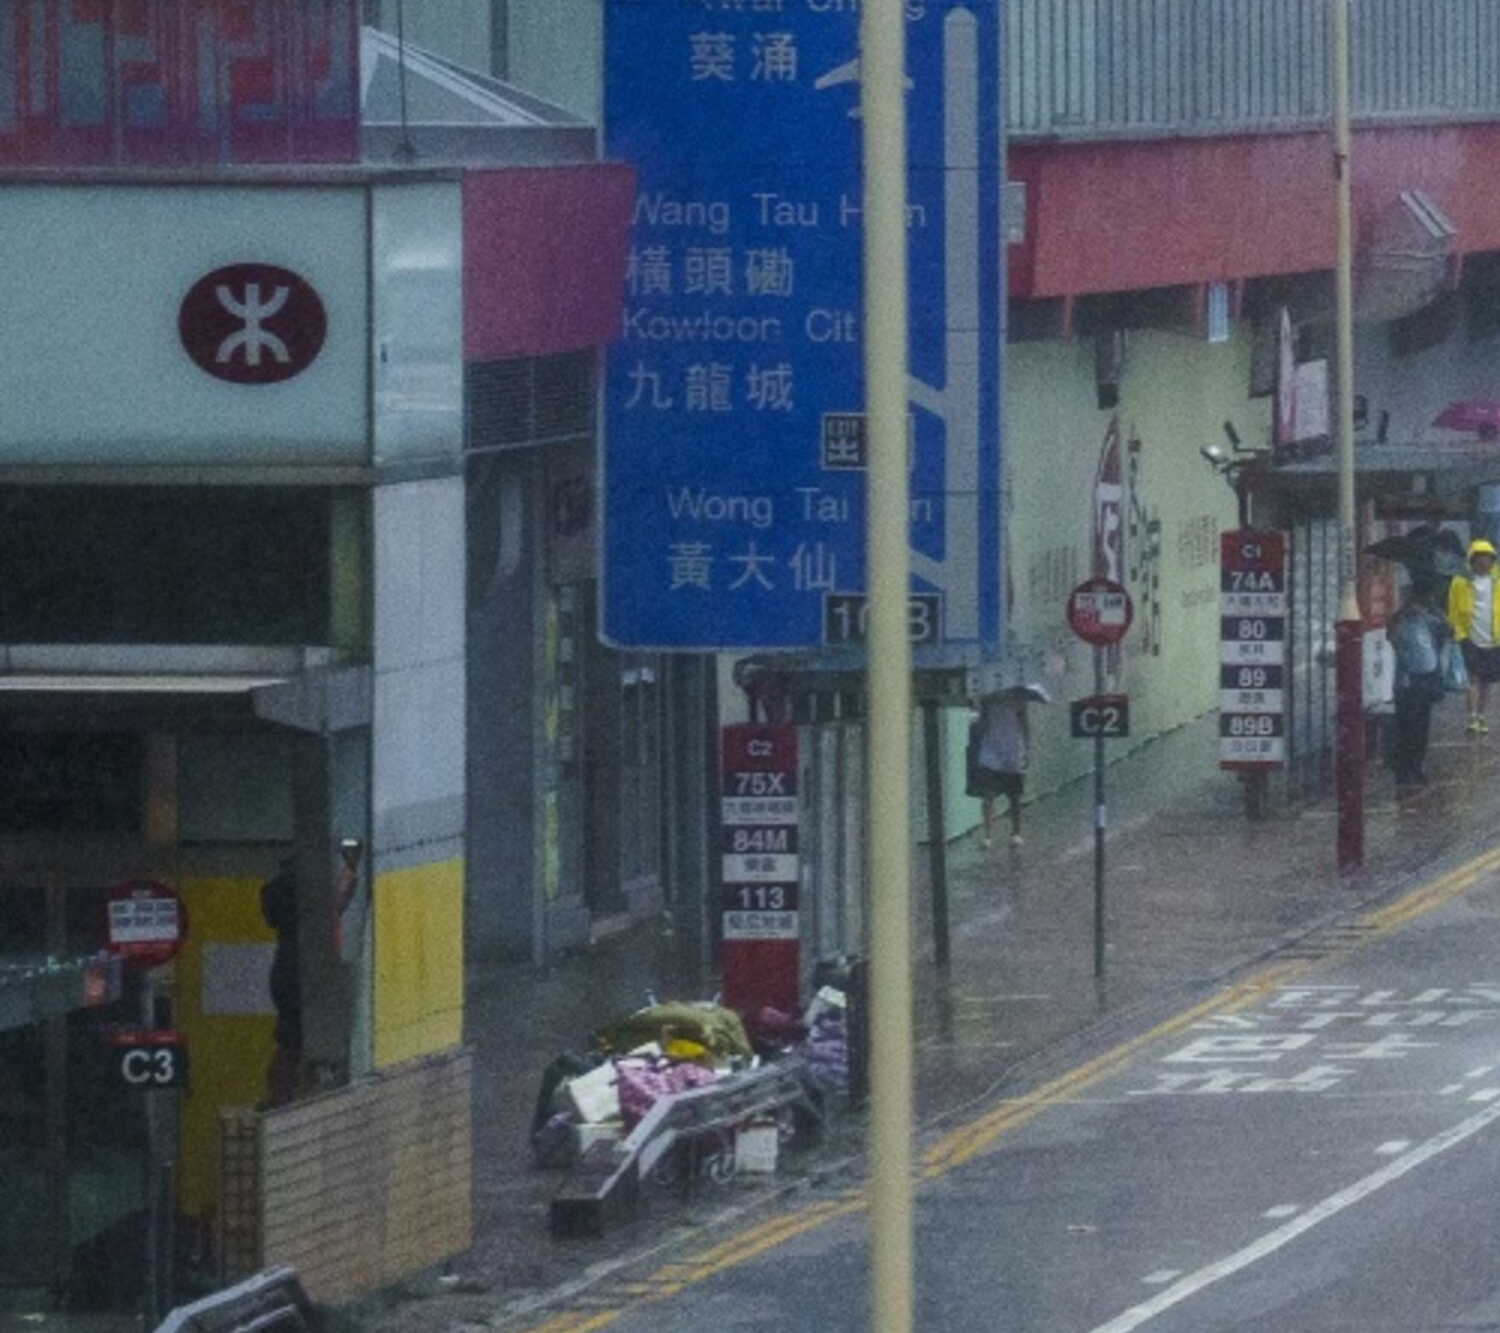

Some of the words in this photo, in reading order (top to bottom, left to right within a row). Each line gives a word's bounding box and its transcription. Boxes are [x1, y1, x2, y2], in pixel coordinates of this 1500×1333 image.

[690, 31, 798, 82] 葵涌
[752, 192, 819, 226] Tau
[622, 307, 781, 343] Kowloon
[806, 309, 858, 343] Cit
[624, 363, 795, 412] 九龍城
[667, 486, 773, 528] Wong
[795, 486, 849, 522] Tai
[667, 540, 836, 592] 黃大仙
[1231, 571, 1275, 591] 74A
[1238, 619, 1266, 639] 80
[1238, 667, 1267, 687] 89
[1080, 707, 1121, 733] C2
[1229, 716, 1274, 736] 89B
[746, 739, 773, 756] C2
[736, 772, 785, 795] 75X
[732, 829, 788, 851] 84M
[737, 887, 785, 910] 113
[1152, 1033, 1440, 1063] 巴士
[120, 1048, 175, 1084] C3
